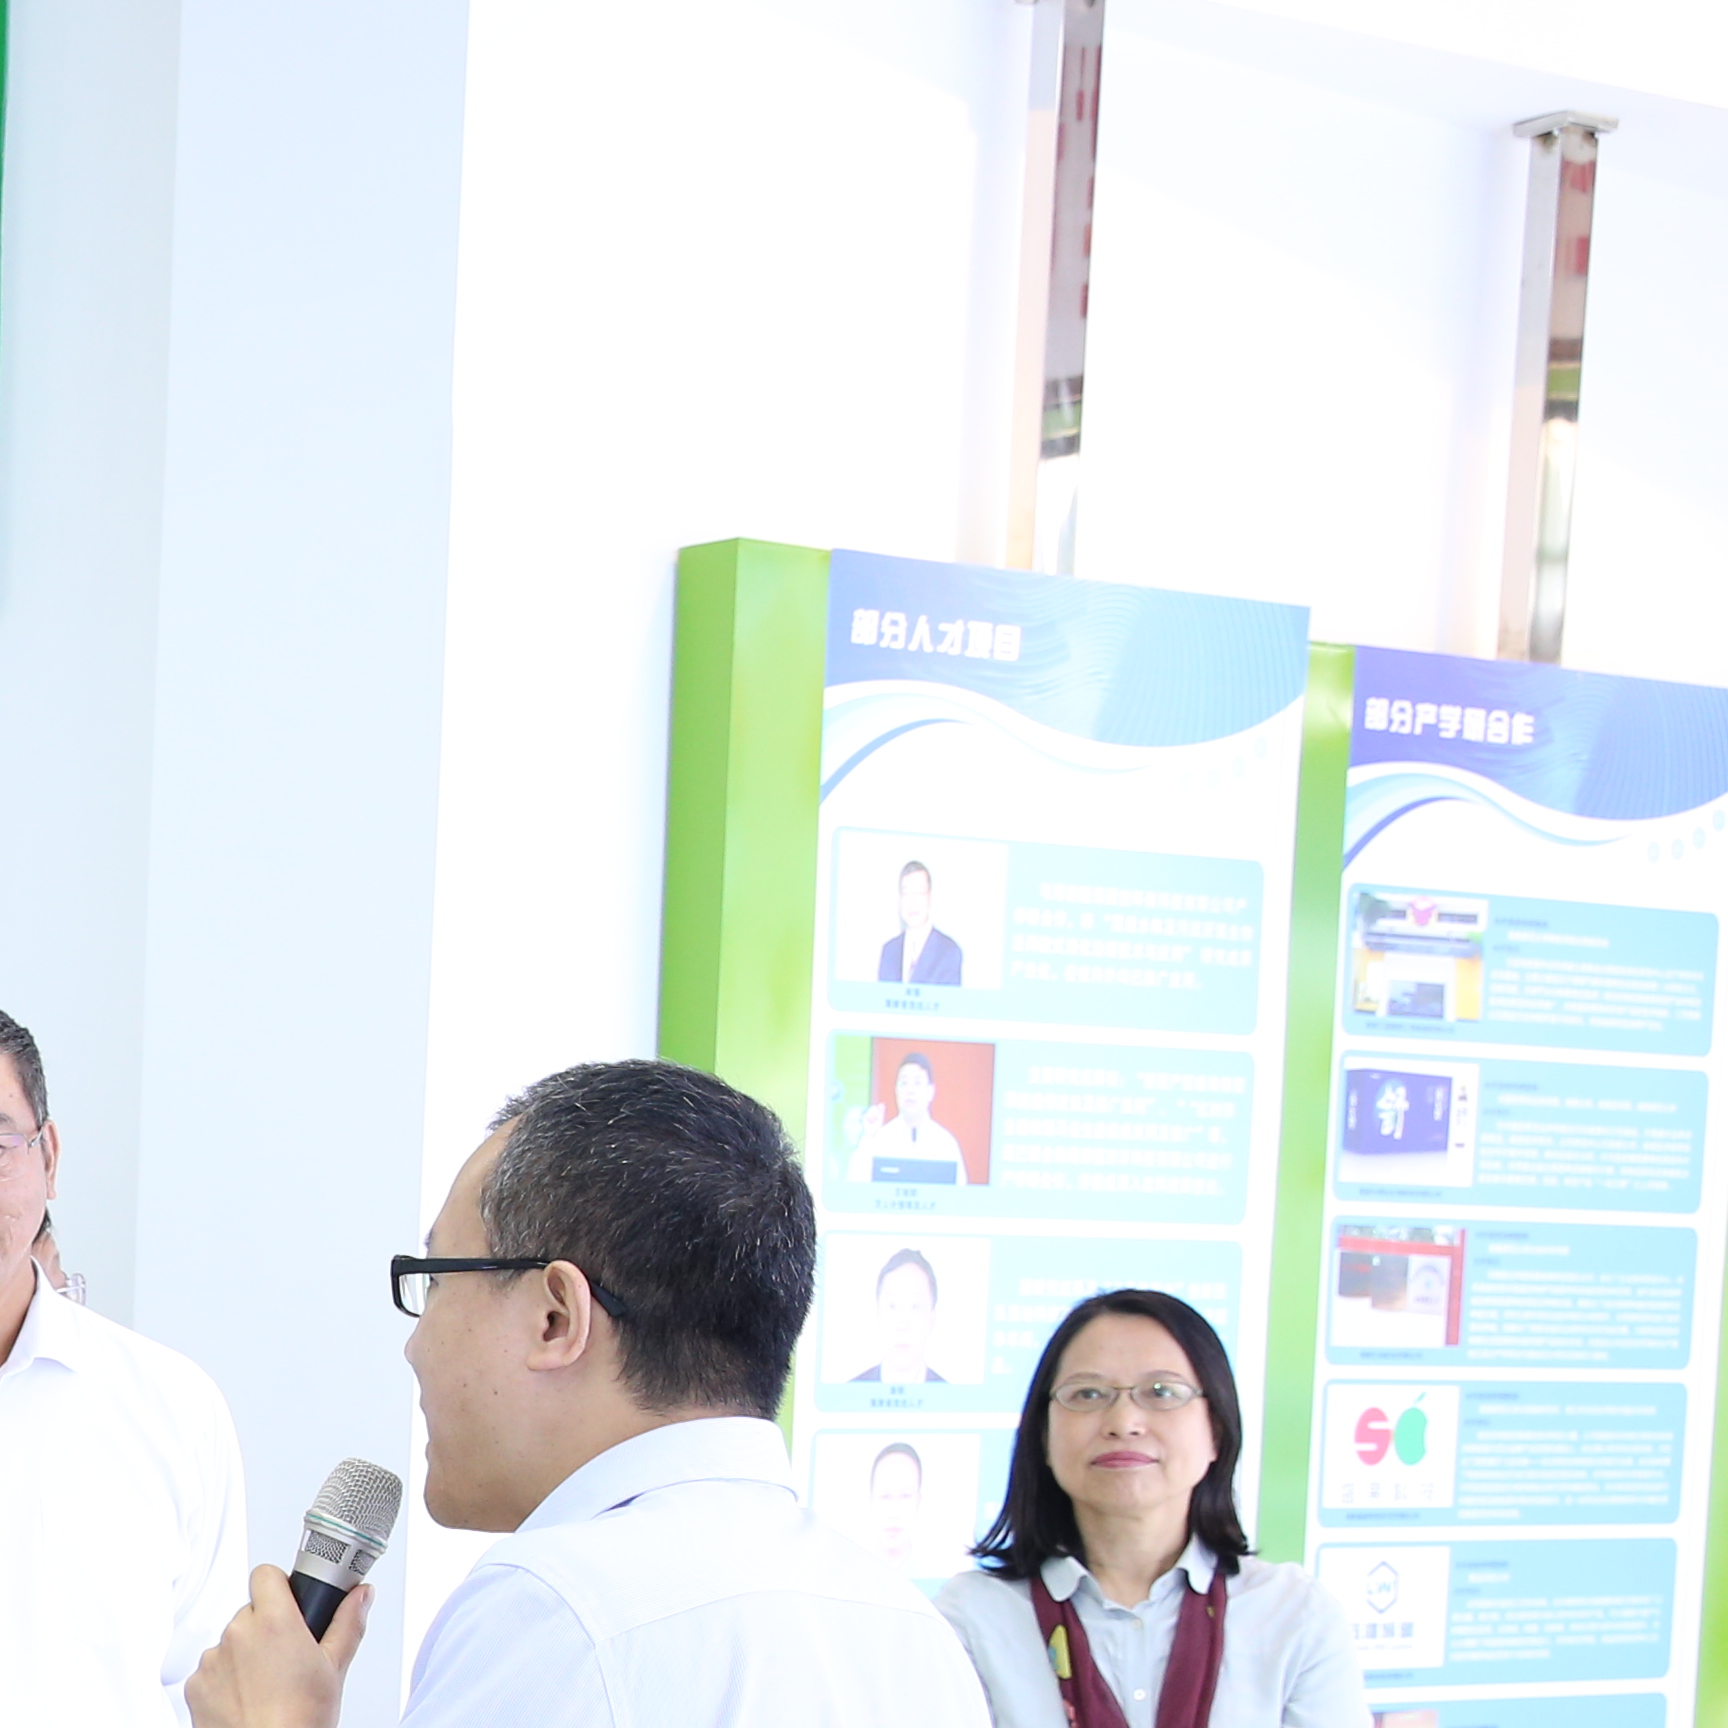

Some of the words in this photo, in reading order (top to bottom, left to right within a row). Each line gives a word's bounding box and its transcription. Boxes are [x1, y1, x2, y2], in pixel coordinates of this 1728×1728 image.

[849, 607, 1022, 662] 部分人才项目
[1364, 696, 1535, 746] 部分产学研合作
